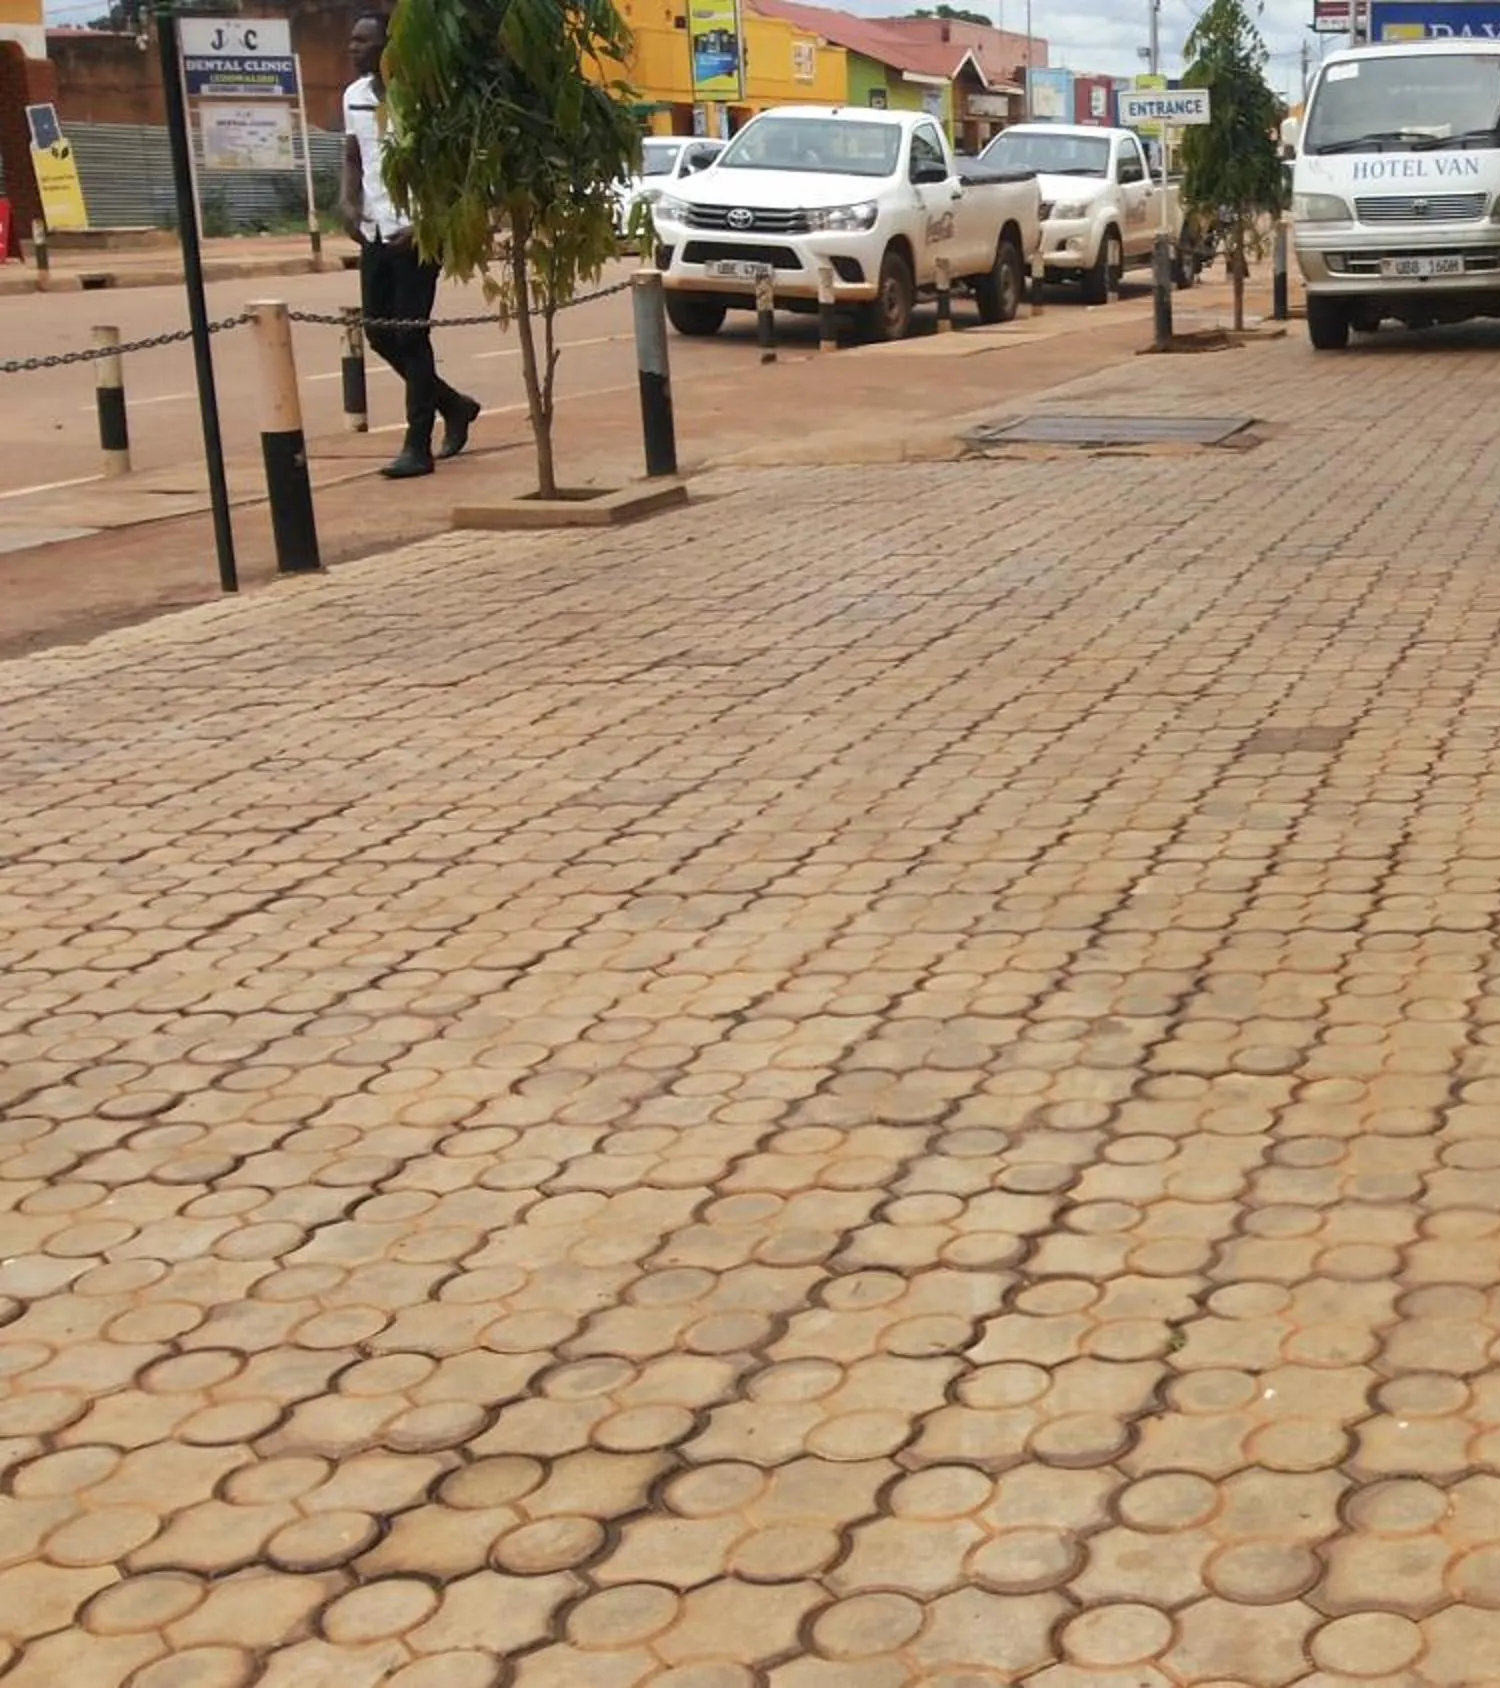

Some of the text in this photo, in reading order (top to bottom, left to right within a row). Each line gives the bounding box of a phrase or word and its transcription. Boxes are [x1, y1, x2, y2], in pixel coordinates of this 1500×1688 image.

[244, 28, 258, 51] C
[184, 59, 293, 72] DENTAL CLINIC
[1128, 99, 1204, 117] ENTRANCE
[1353, 157, 1480, 180] HOTEL VAN
